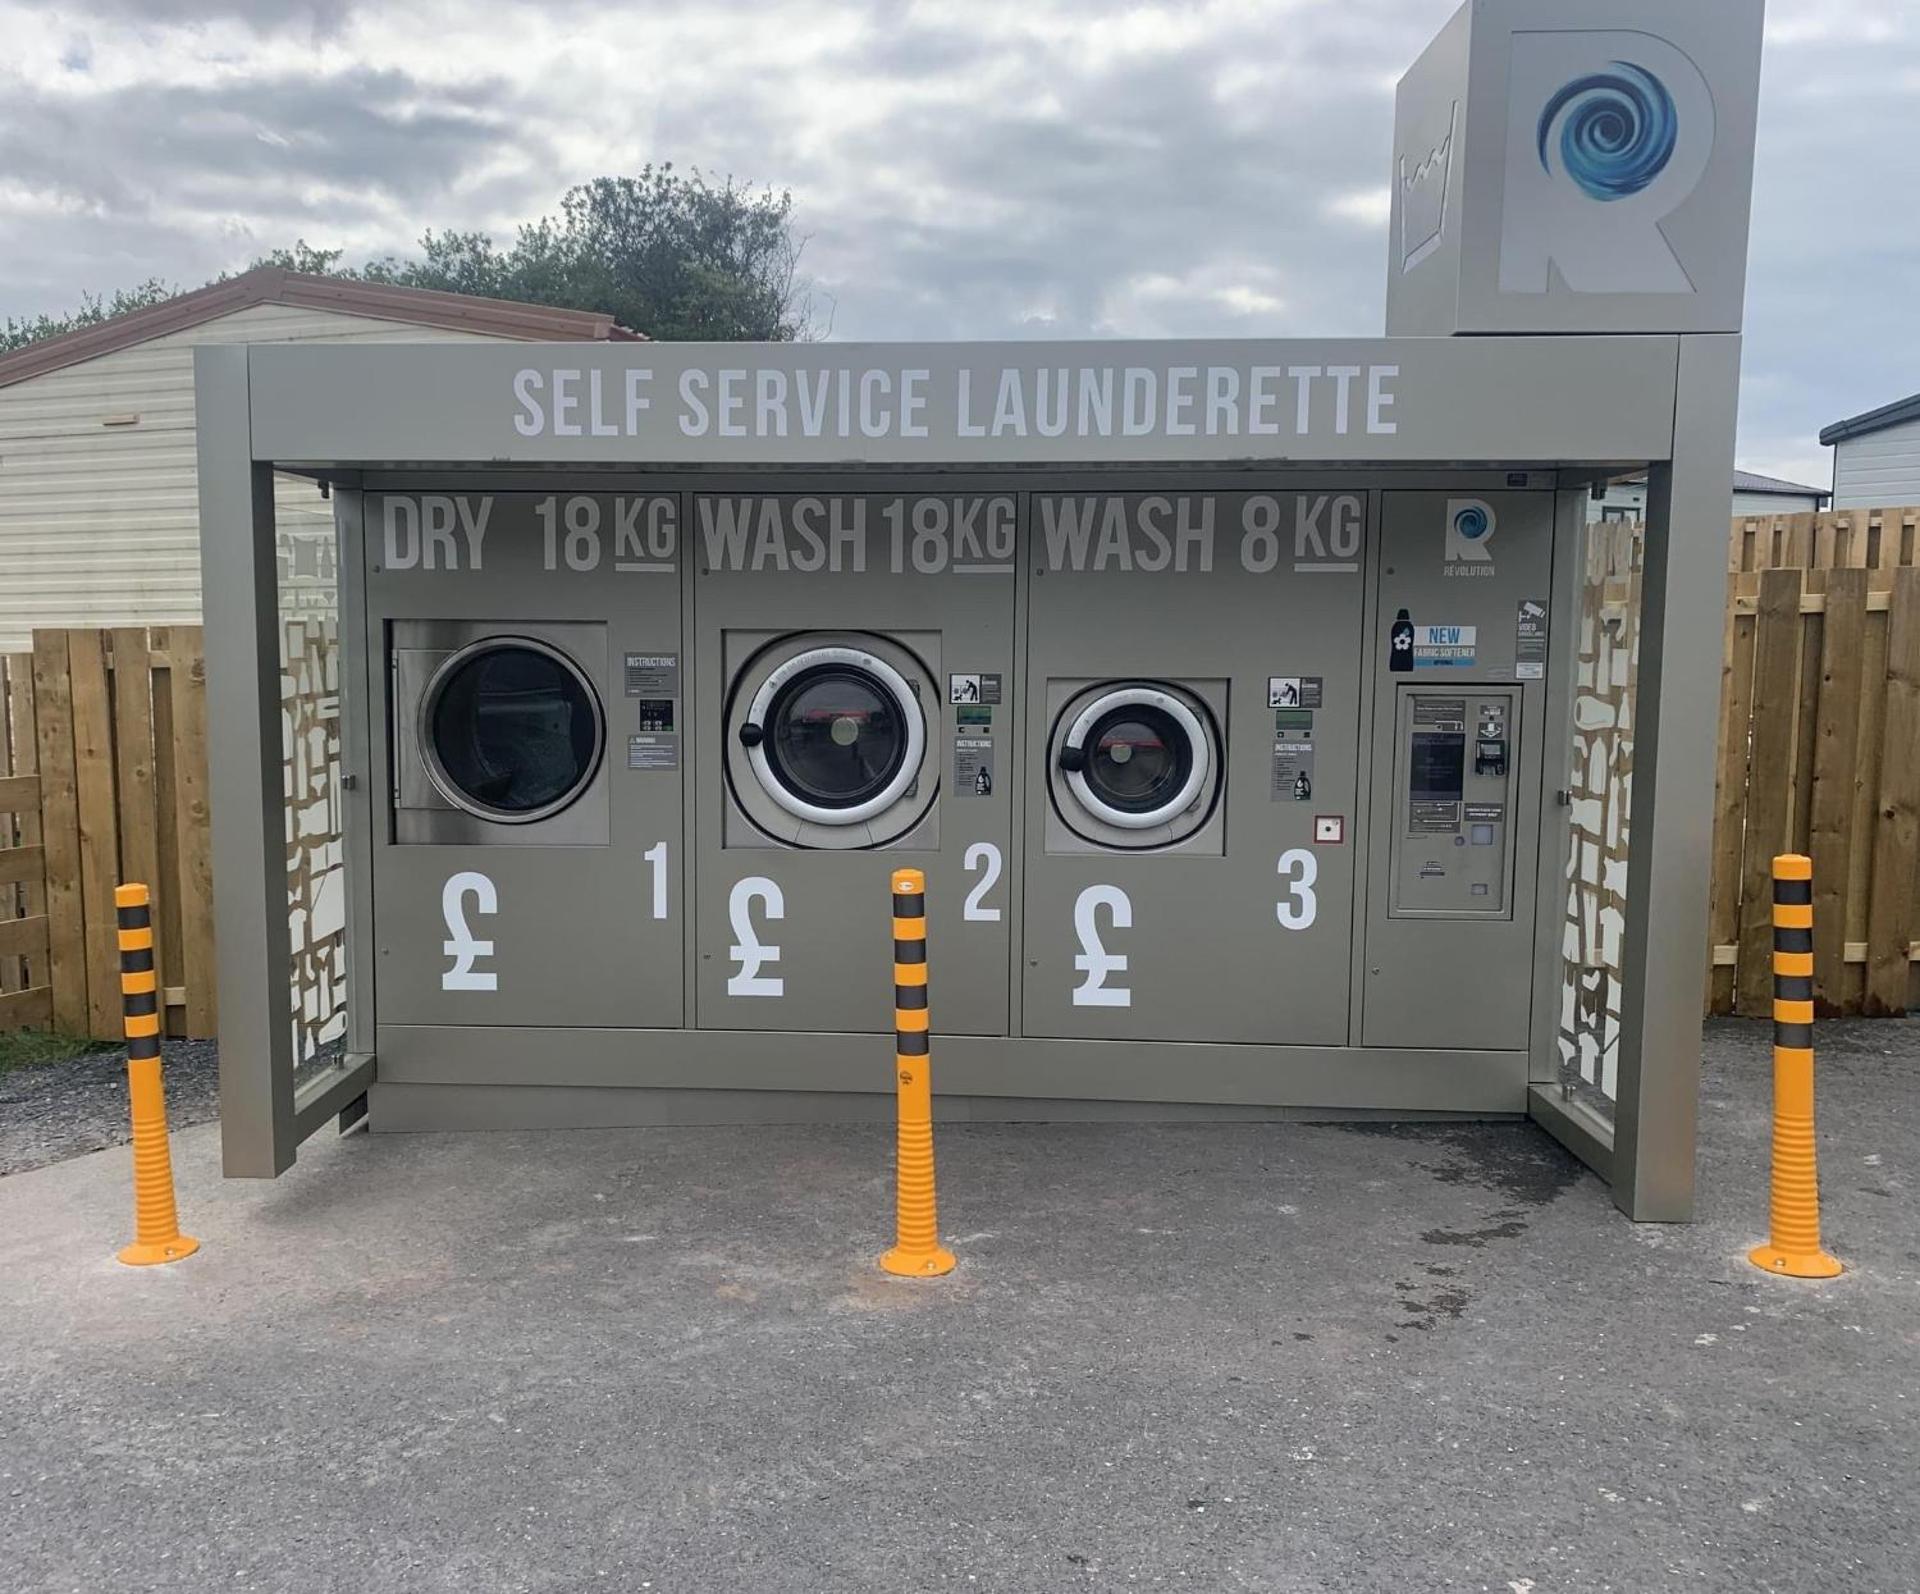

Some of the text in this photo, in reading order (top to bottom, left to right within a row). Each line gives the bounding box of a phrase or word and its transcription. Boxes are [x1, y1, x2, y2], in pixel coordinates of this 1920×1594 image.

[513, 365, 1399, 437] SELF SERVICE LAUNDERETTE
[383, 496, 676, 571] DRY 18 KG
[699, 498, 866, 573] WASH
[1041, 496, 1361, 573] WASH 8 KG
[626, 657, 676, 667] INSTRUCTIONS
[1429, 628, 1460, 644] NEW
[643, 841, 667, 919] 1
[963, 842, 1002, 921] 2
[1276, 849, 1318, 931] 3
[442, 871, 498, 991] £
[727, 876, 785, 997] £
[1072, 884, 1132, 1007] £
